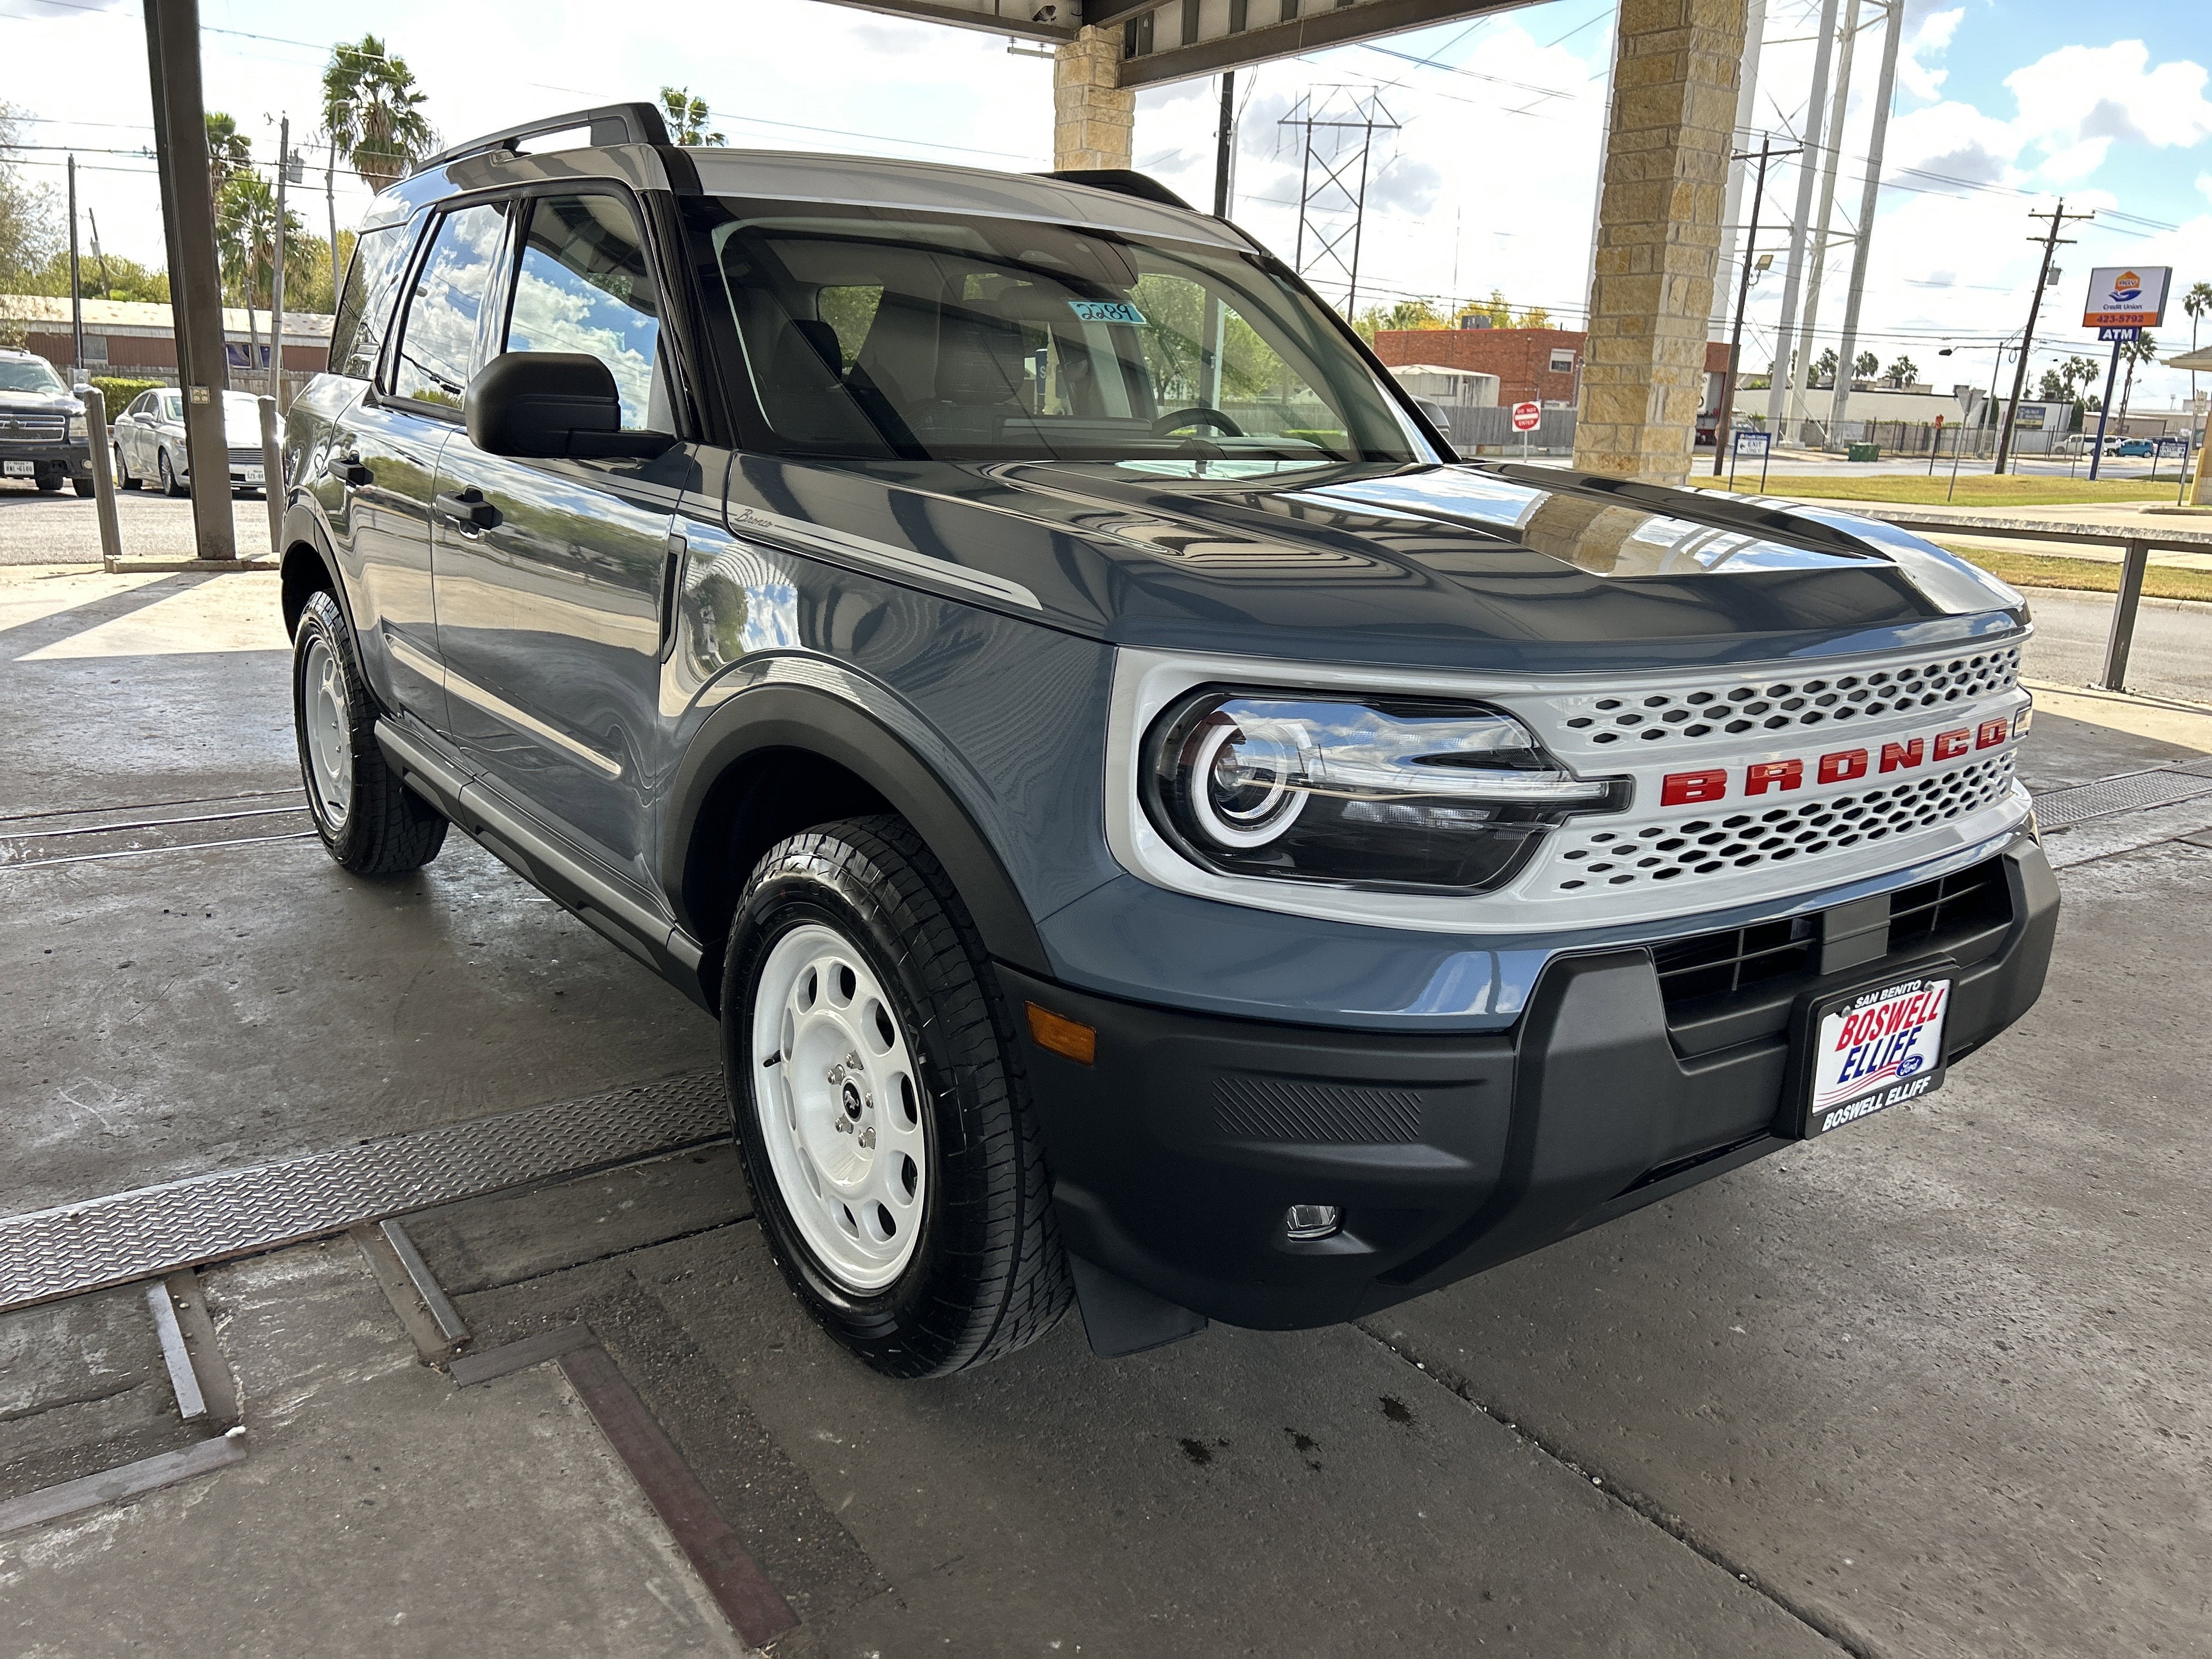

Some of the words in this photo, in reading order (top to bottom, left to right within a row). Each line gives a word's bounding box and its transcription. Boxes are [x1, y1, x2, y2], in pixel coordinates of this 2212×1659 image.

[1076, 303, 1134, 321] 2289
[2097, 314, 2145, 323] 423-5792
[2102, 329, 2134, 340] ATM
[734, 509, 774, 528] Bronco
[1660, 716, 2008, 808] BRONCO
[1854, 991, 1880, 1008] SAN
[1880, 979, 1922, 1001] BENITO
[1835, 988, 1945, 1052] BOSWELL
[1836, 1025, 1923, 1084] ELLIFF
[1821, 1092, 1885, 1132] BOSWELL
[1884, 1075, 1932, 1107] ELLIFF
